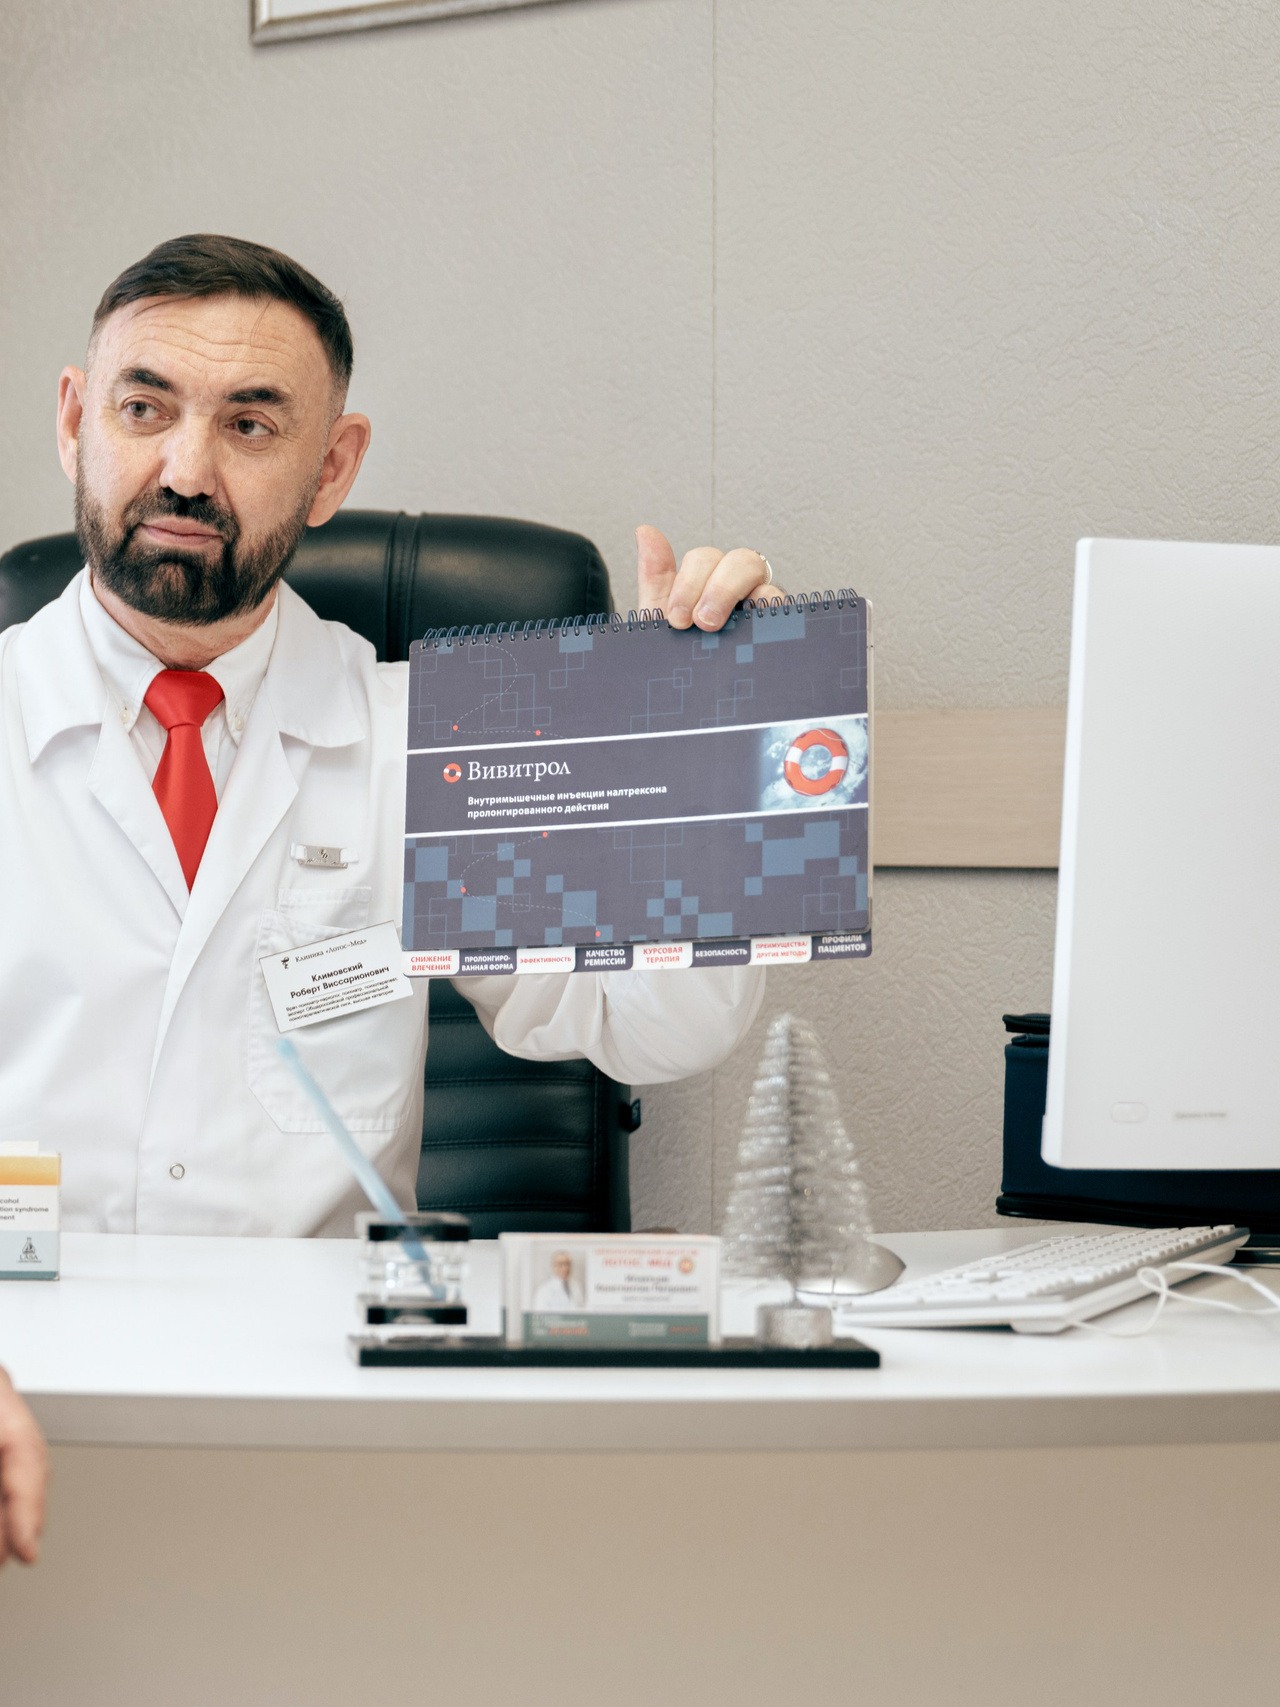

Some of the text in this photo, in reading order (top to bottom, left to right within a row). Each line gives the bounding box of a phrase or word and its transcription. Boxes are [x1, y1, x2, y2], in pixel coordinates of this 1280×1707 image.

[467, 761, 571, 782] Вивитрол
[467, 785, 667, 807] Внутримышечные инъекции налтрексона
[467, 802, 609, 819] пролонгированного действия
[822, 934, 863, 944] ПРОФИЛИ
[755, 940, 808, 949] ПРЕИМУЩЕСТВА/
[818, 943, 867, 954] ПАЦИЕНТОВ
[585, 949, 625, 958] КАЧЕСТВО
[643, 946, 683, 955] КУРСОВАЯ
[695, 948, 748, 958] БЕЗОПАСНОСТЬ
[756, 949, 807, 959] ДРУГИЕ МЕТОДЫ
[295, 950, 324, 963] Клиника
[410, 955, 452, 963] СНИЖЕНИЕ
[464, 955, 511, 964] ПРОЛОНГИРО-
[520, 955, 572, 964] ЭФФЕКТИВНОСТЬ
[646, 955, 680, 964] ТЕРАПИЯ
[461, 962, 514, 972] ВАННАЯ ФОРМА
[584, 957, 626, 967] РЕМИССИИ
[311, 962, 363, 982] Климовский
[411, 963, 451, 972] ВЛЕЧЕНИЯ
[290, 965, 390, 999] Роберт Виссарионович
[14, 1205, 49, 1214] syndrome
